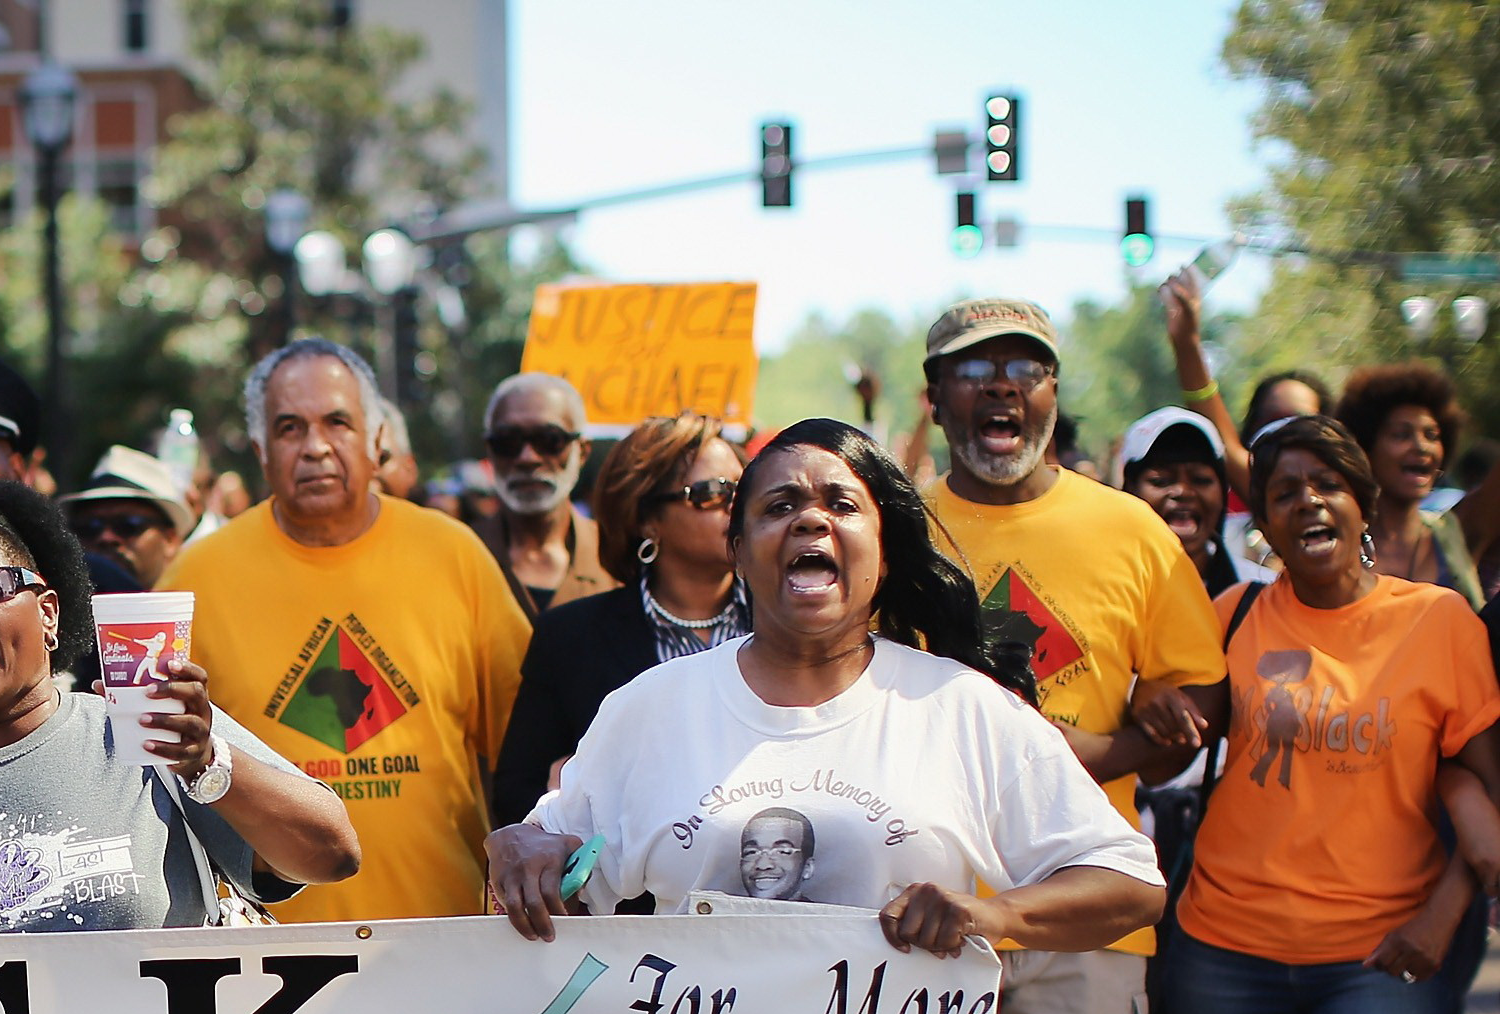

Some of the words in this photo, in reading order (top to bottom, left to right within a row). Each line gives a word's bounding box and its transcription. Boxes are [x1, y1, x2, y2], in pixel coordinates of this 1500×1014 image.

[534, 284, 754, 346] JUSTICE
[558, 362, 740, 417] ICHAEL
[263, 663, 305, 719] UNIVERSAL
[298, 616, 333, 662] AFRICAN
[370, 646, 421, 707] ORGANIZATION
[1293, 685, 1398, 756] Black
[332, 780, 402, 799] DESTINY
[346, 757, 378, 776] ONE
[383, 755, 420, 774] GOAL
[672, 814, 703, 850] In
[699, 777, 784, 815] Loving
[790, 768, 892, 823] Memory
[72, 872, 146, 904] BLAST
